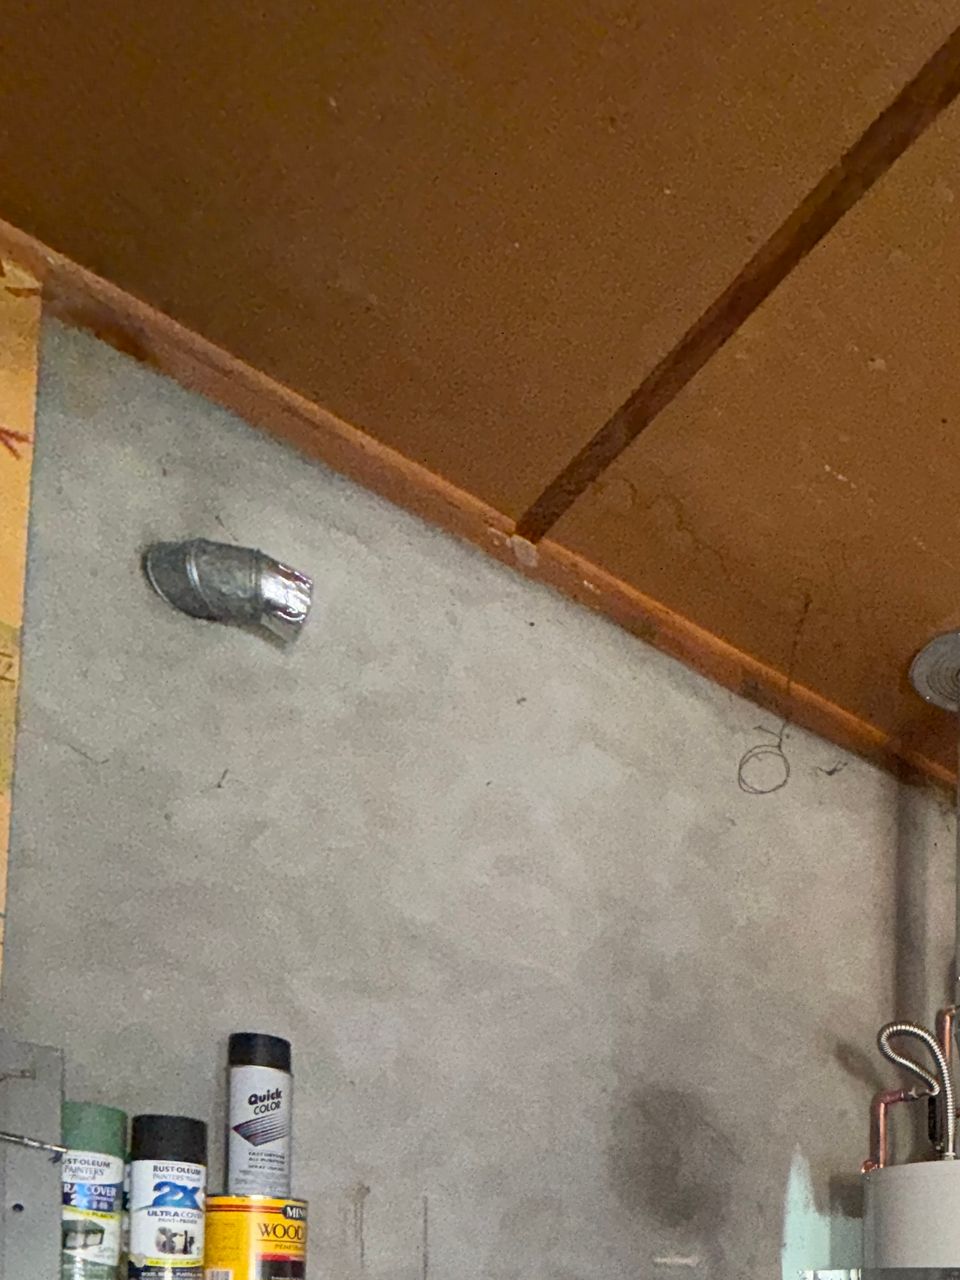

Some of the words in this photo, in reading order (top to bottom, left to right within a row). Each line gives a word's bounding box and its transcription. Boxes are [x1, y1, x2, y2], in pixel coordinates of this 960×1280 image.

[248, 1088, 283, 1106] Quick
[253, 1101, 282, 1115] COLOR
[152, 1181, 201, 1209] 2X
[286, 1207, 305, 1218] MIN
